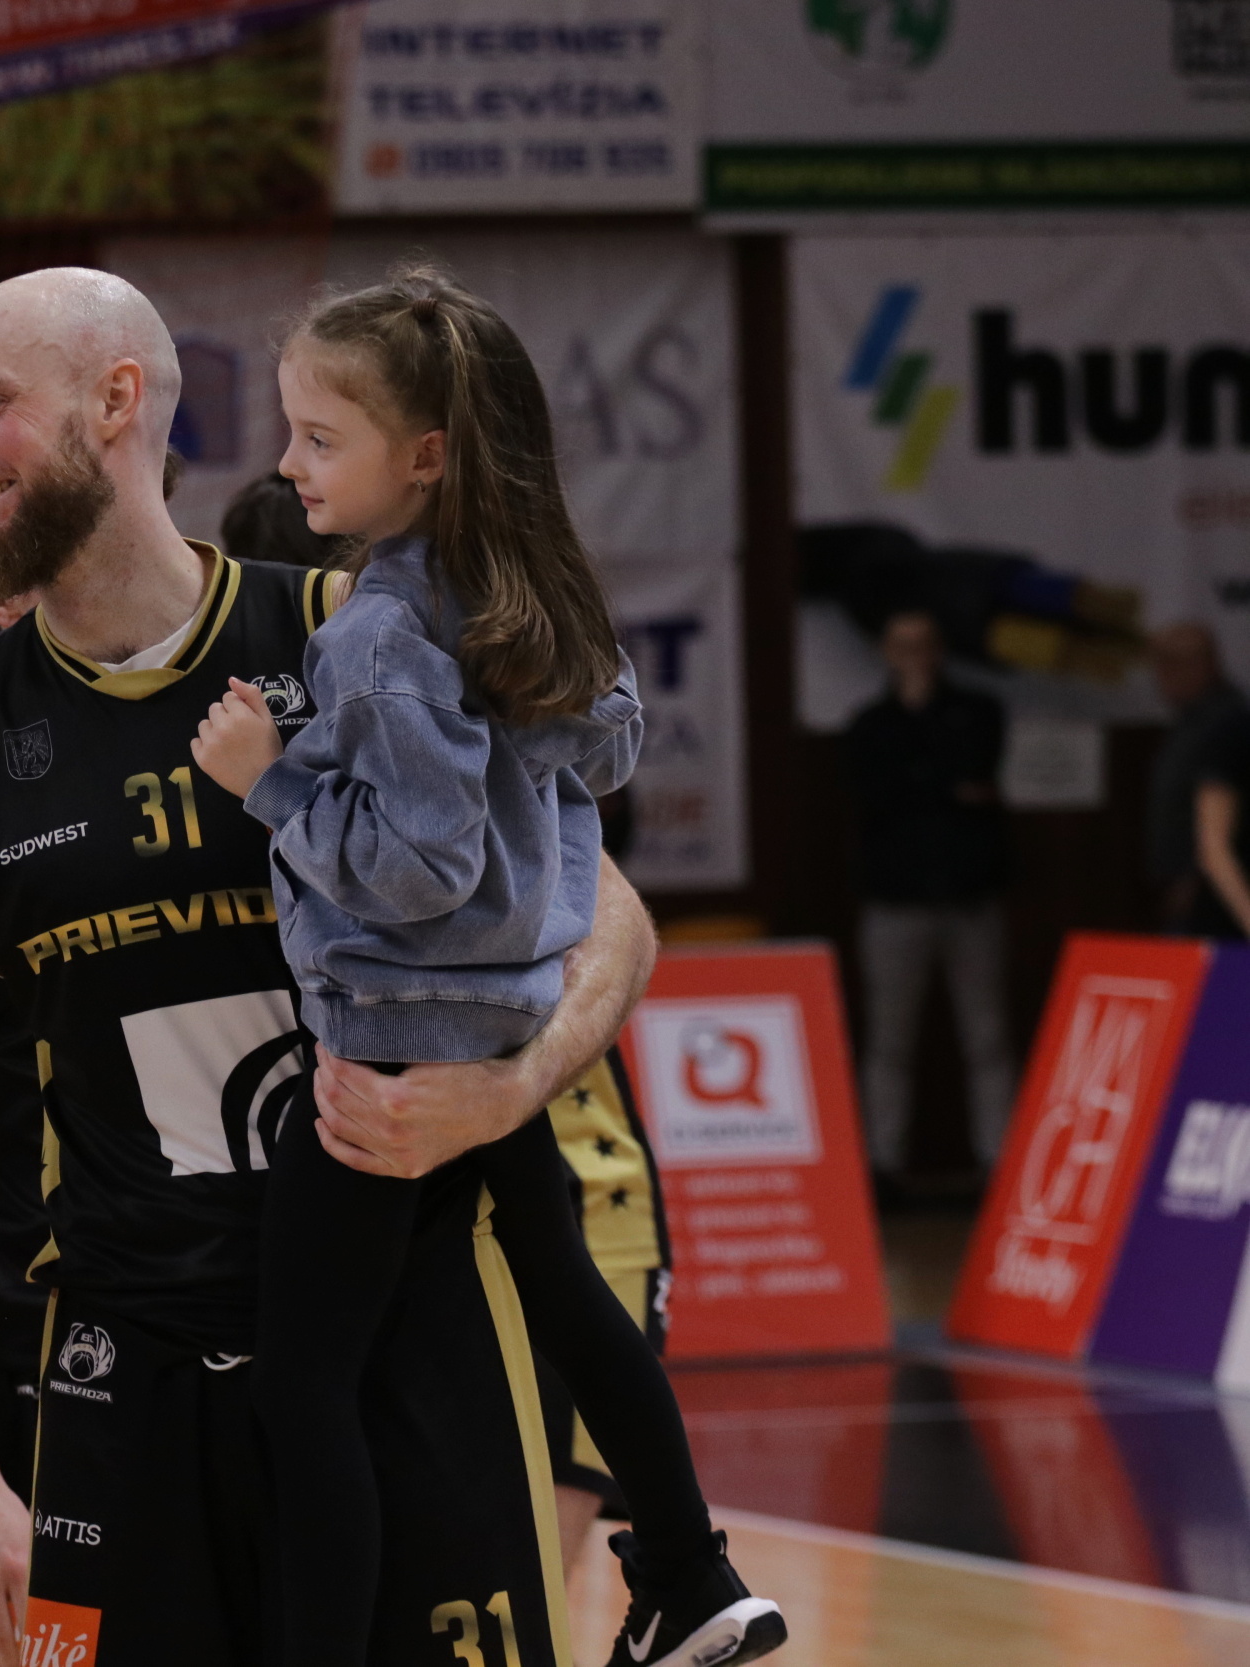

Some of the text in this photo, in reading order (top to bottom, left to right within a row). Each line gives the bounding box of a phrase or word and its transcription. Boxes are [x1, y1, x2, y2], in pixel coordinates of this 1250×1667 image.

[361, 22, 664, 58] INTERNET
[366, 70, 667, 122] TELEVÍZIA
[265, 681, 282, 689] BC
[124, 766, 203, 858] 31
[0, 821, 90, 865] SÜDWEST
[50, 1380, 112, 1402] PRIEVIDZA
[41, 1515, 102, 1546] ATTIS
[430, 1591, 521, 1667] 31
